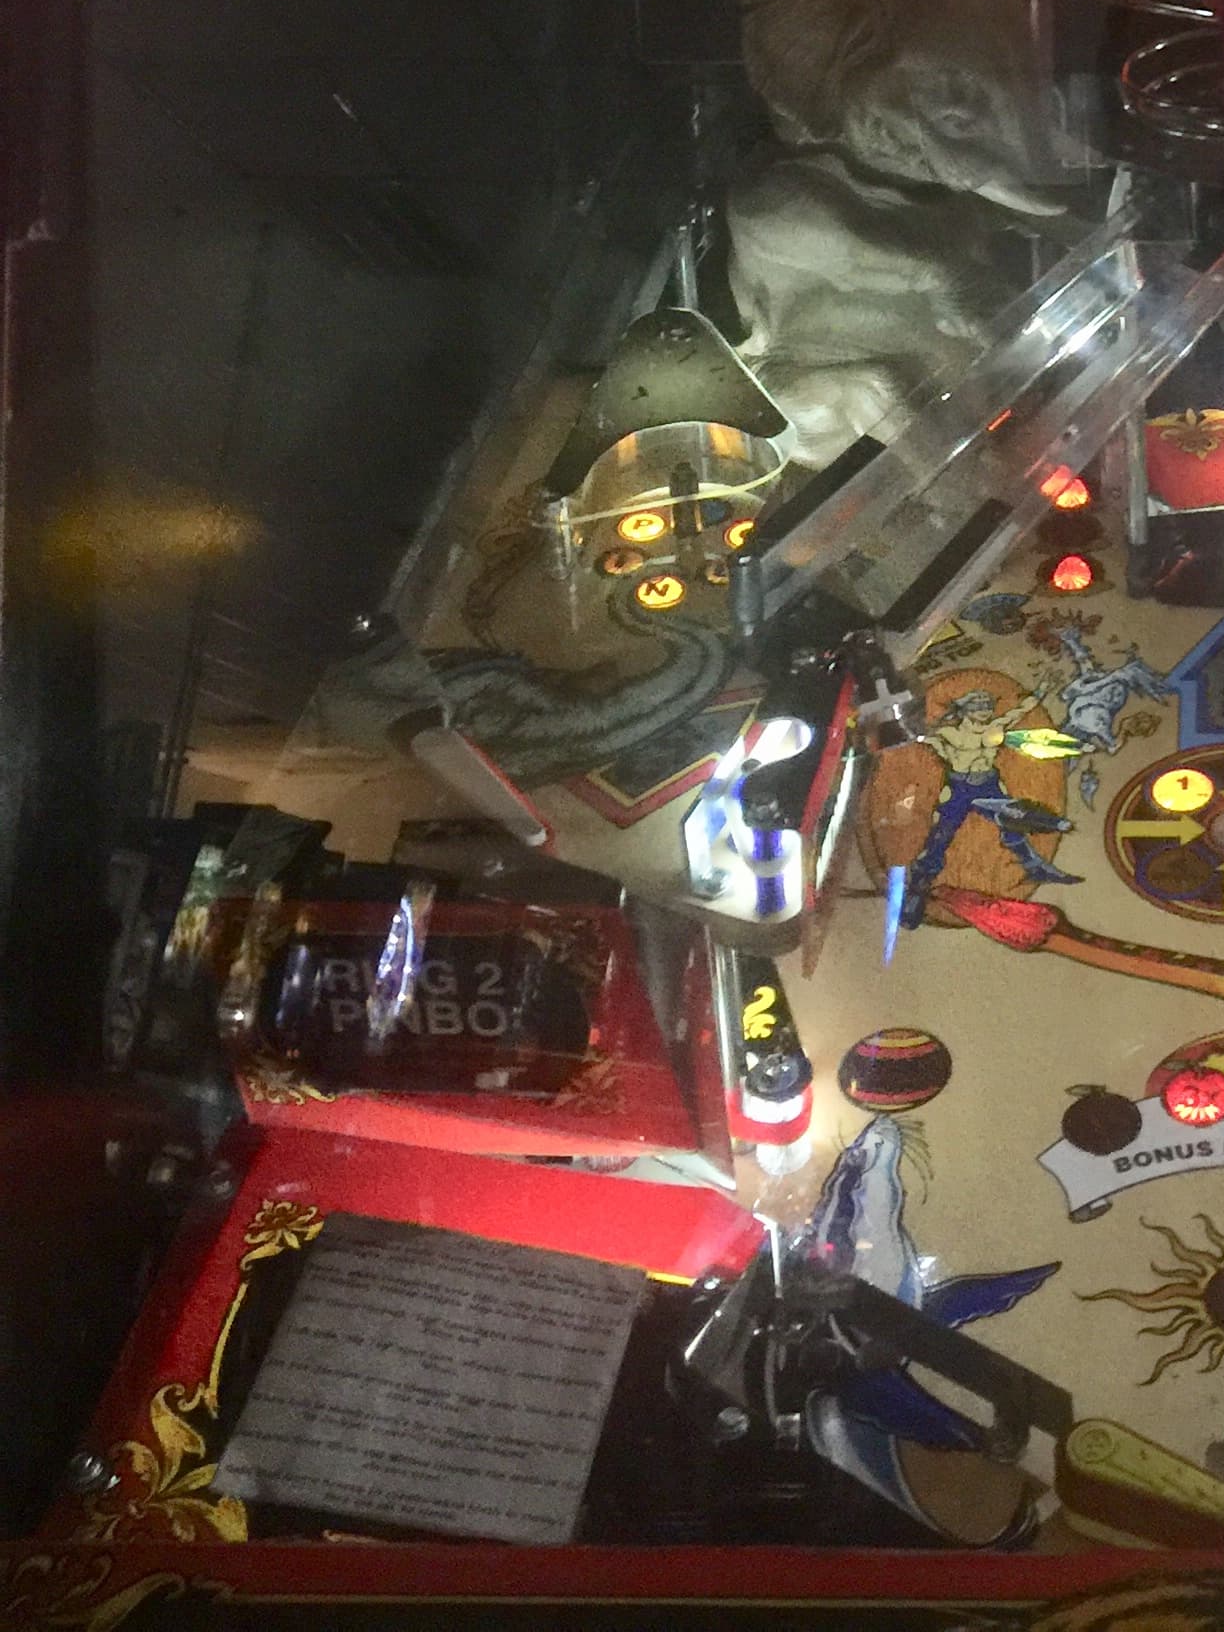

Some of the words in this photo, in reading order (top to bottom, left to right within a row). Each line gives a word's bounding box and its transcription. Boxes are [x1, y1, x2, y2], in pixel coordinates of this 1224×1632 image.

[1176, 775, 1191, 791] 1
[322, 959, 458, 996] RIG
[474, 962, 506, 997] 2
[330, 997, 508, 1038] PNBO
[1113, 1141, 1214, 1175] BONUS
